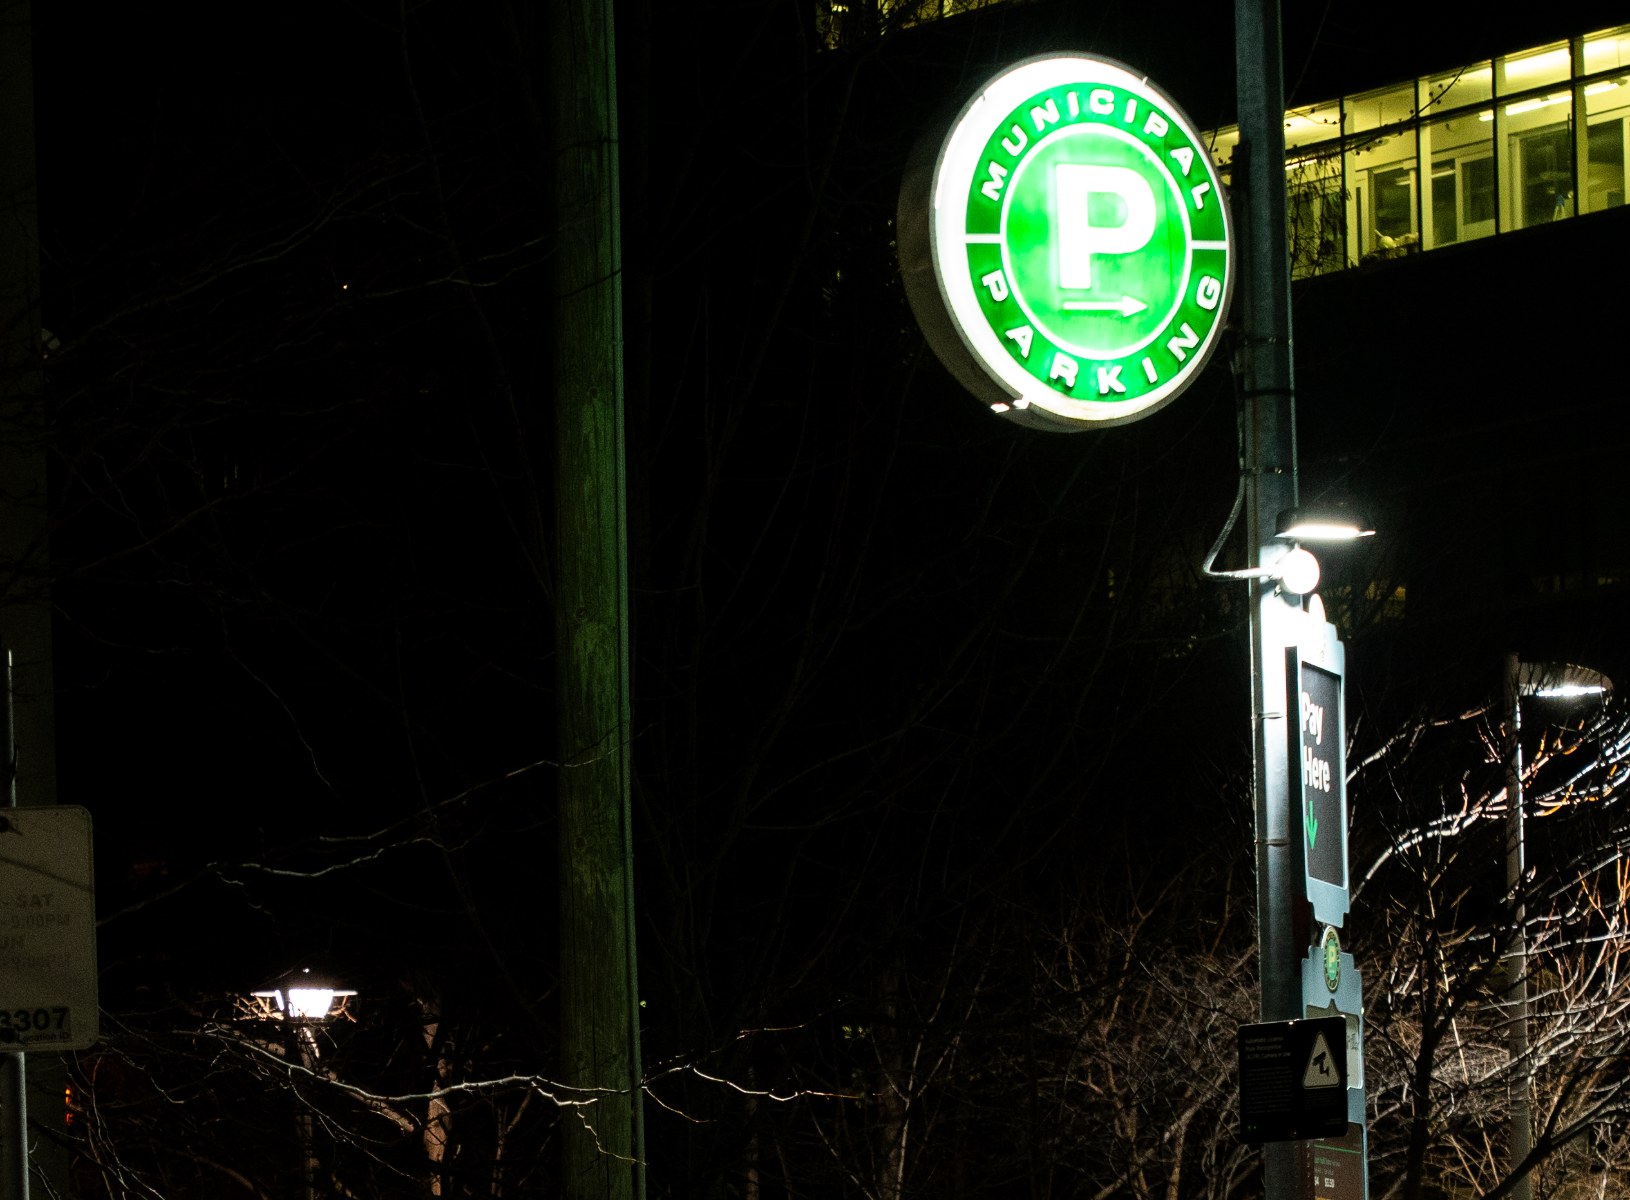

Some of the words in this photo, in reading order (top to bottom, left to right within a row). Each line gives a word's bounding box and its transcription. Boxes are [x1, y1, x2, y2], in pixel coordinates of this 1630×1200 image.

[981, 88, 1210, 210] MUNICIPAL
[1056, 163, 1157, 290] P
[982, 270, 1222, 395] PARKING
[1302, 692, 1323, 745] Pay
[1304, 745, 1331, 793] Here
